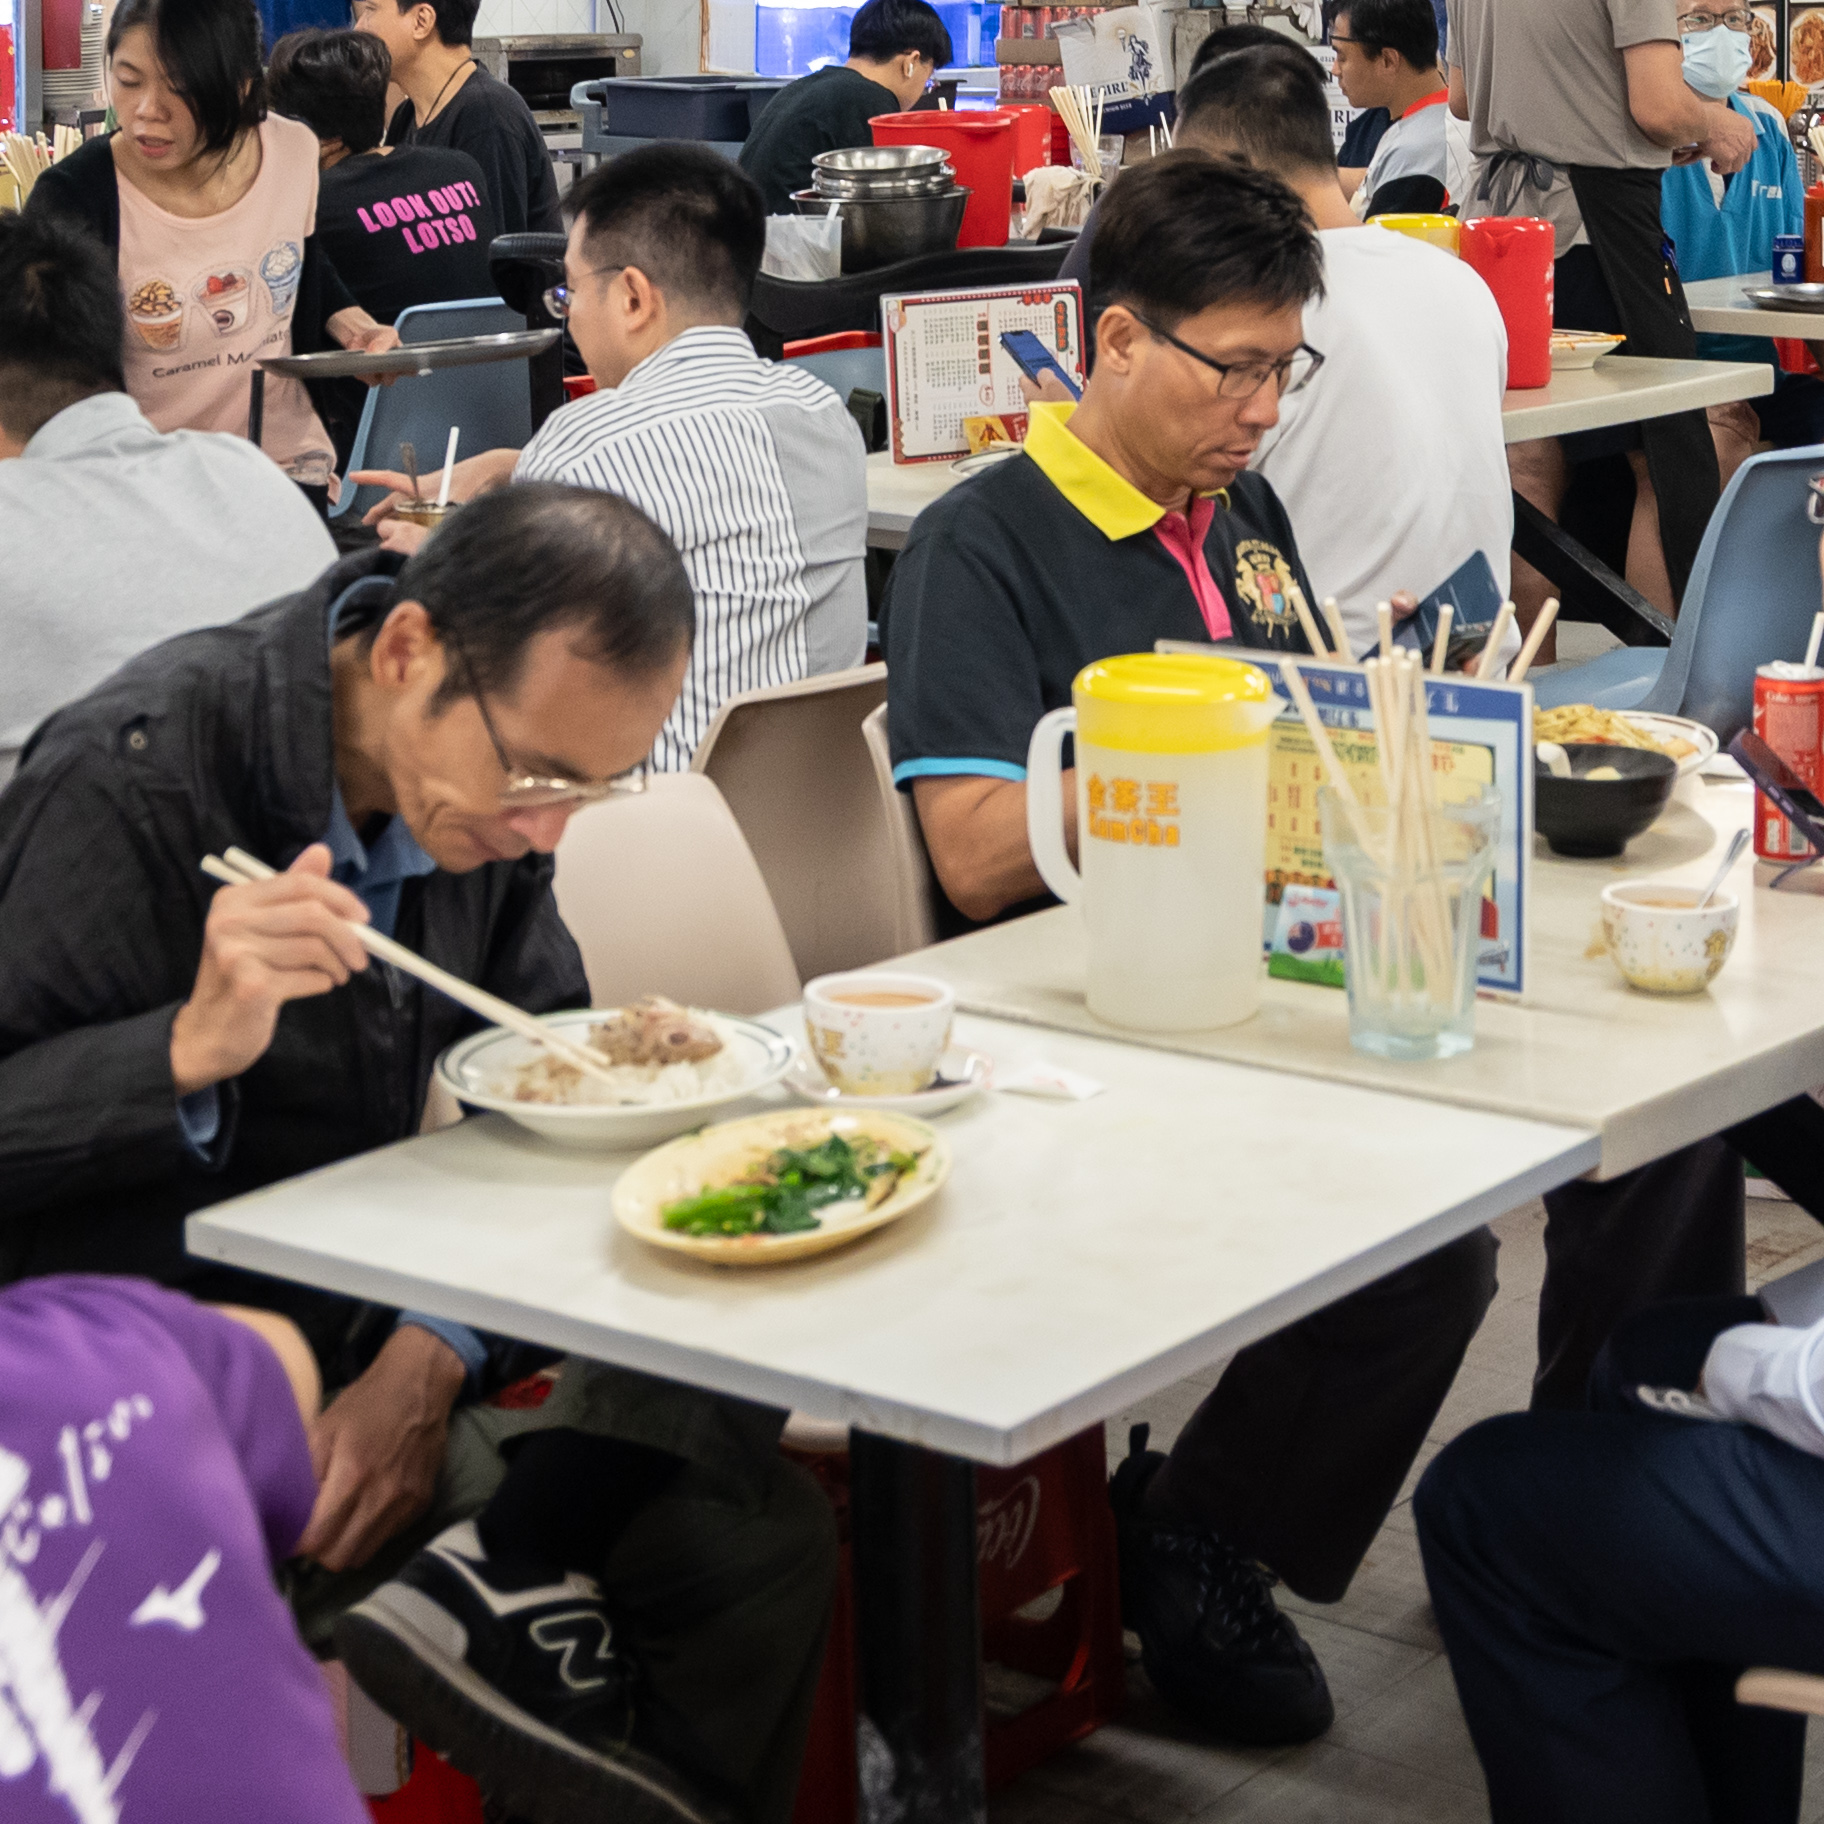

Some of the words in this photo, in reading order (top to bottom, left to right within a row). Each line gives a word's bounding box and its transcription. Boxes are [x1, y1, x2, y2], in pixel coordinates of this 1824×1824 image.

[356, 192, 430, 234] LOOK
[430, 180, 481, 216] OUT!
[401, 213, 477, 255] LOTSO
[152, 354, 221, 378] Caramel
